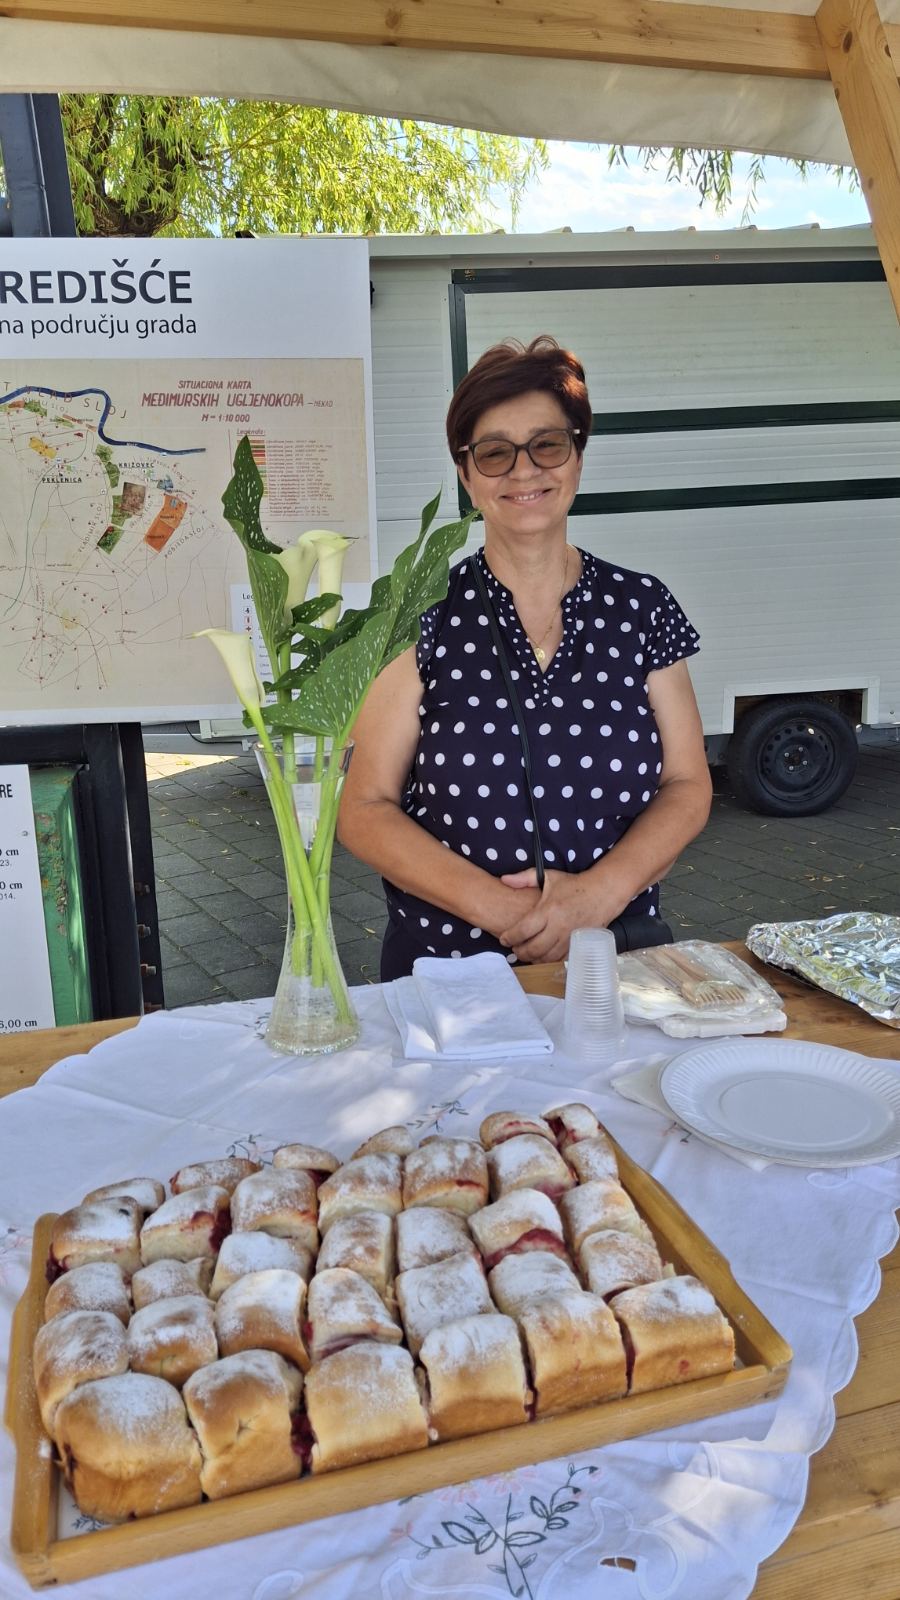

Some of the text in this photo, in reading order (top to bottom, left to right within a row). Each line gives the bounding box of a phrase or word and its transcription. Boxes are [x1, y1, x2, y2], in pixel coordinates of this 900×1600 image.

[0, 314, 197, 339] na području grada
[178, 380, 252, 390] SITUACIONA KARTA
[141, 393, 219, 408] MEĐIMURSKIH
[227, 392, 304, 408] UGLJENOKOPA
